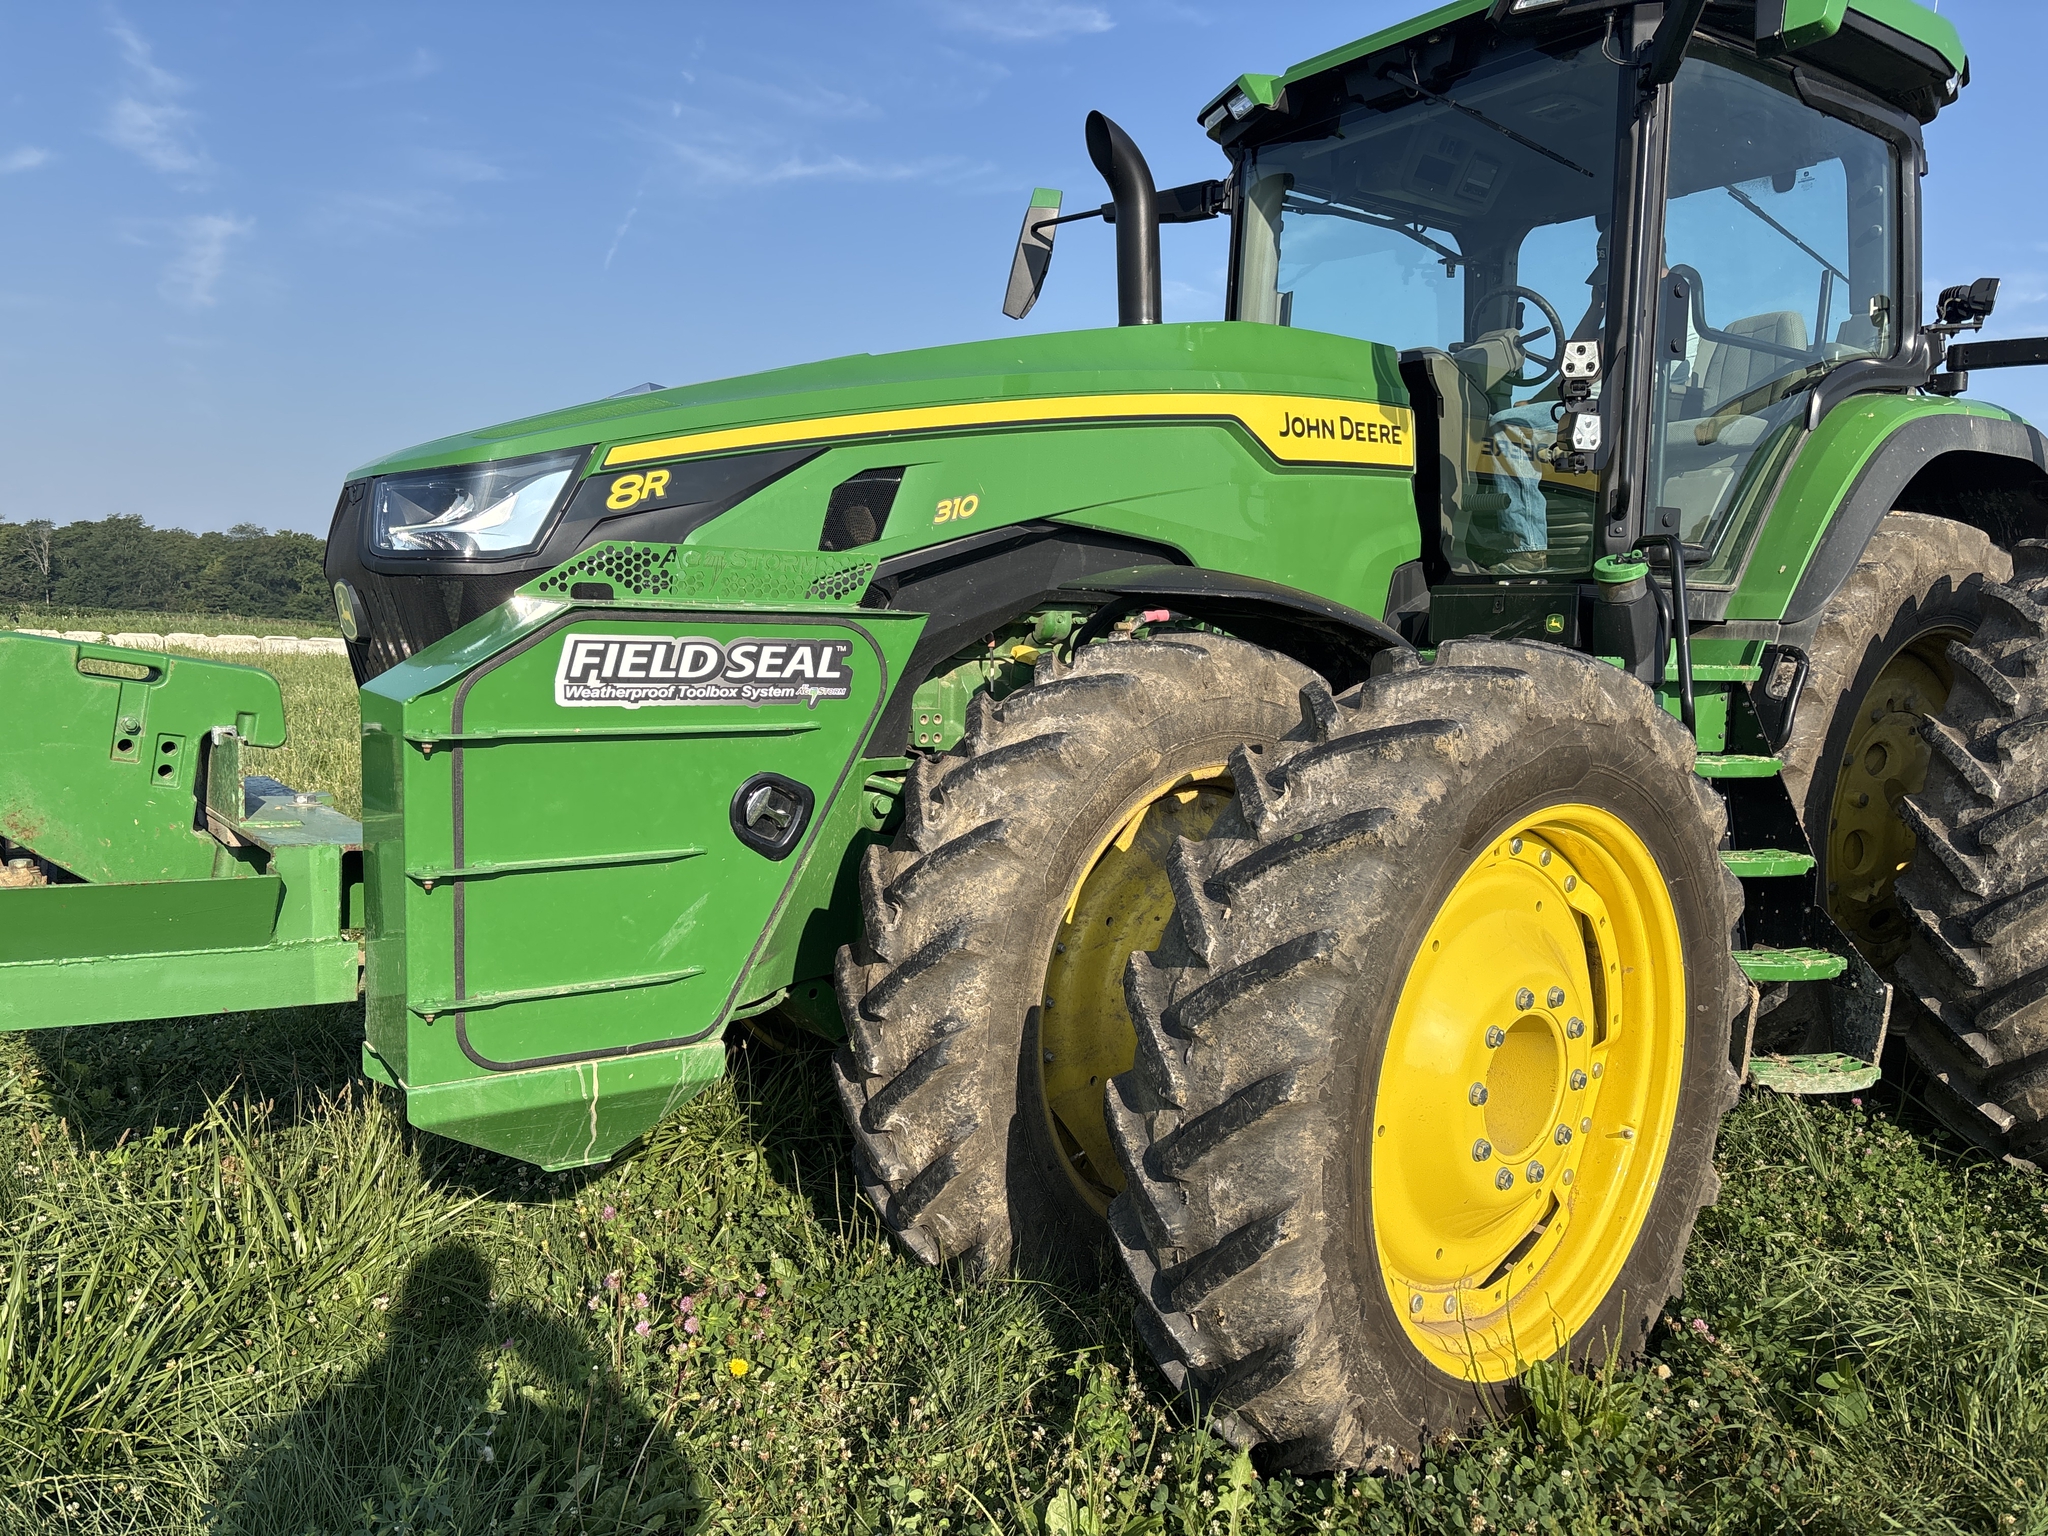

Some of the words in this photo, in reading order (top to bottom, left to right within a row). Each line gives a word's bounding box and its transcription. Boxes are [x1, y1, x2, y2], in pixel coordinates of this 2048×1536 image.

[1279, 411, 1335, 440] JOHN
[1340, 415, 1402, 446] DEERE
[606, 469, 670, 511] 8R
[932, 494, 980, 525] 310
[570, 643, 719, 679] FIELD
[565, 684, 677, 700] Weatherproof
[679, 685, 738, 700] Toolbox
[741, 685, 796, 700] System
